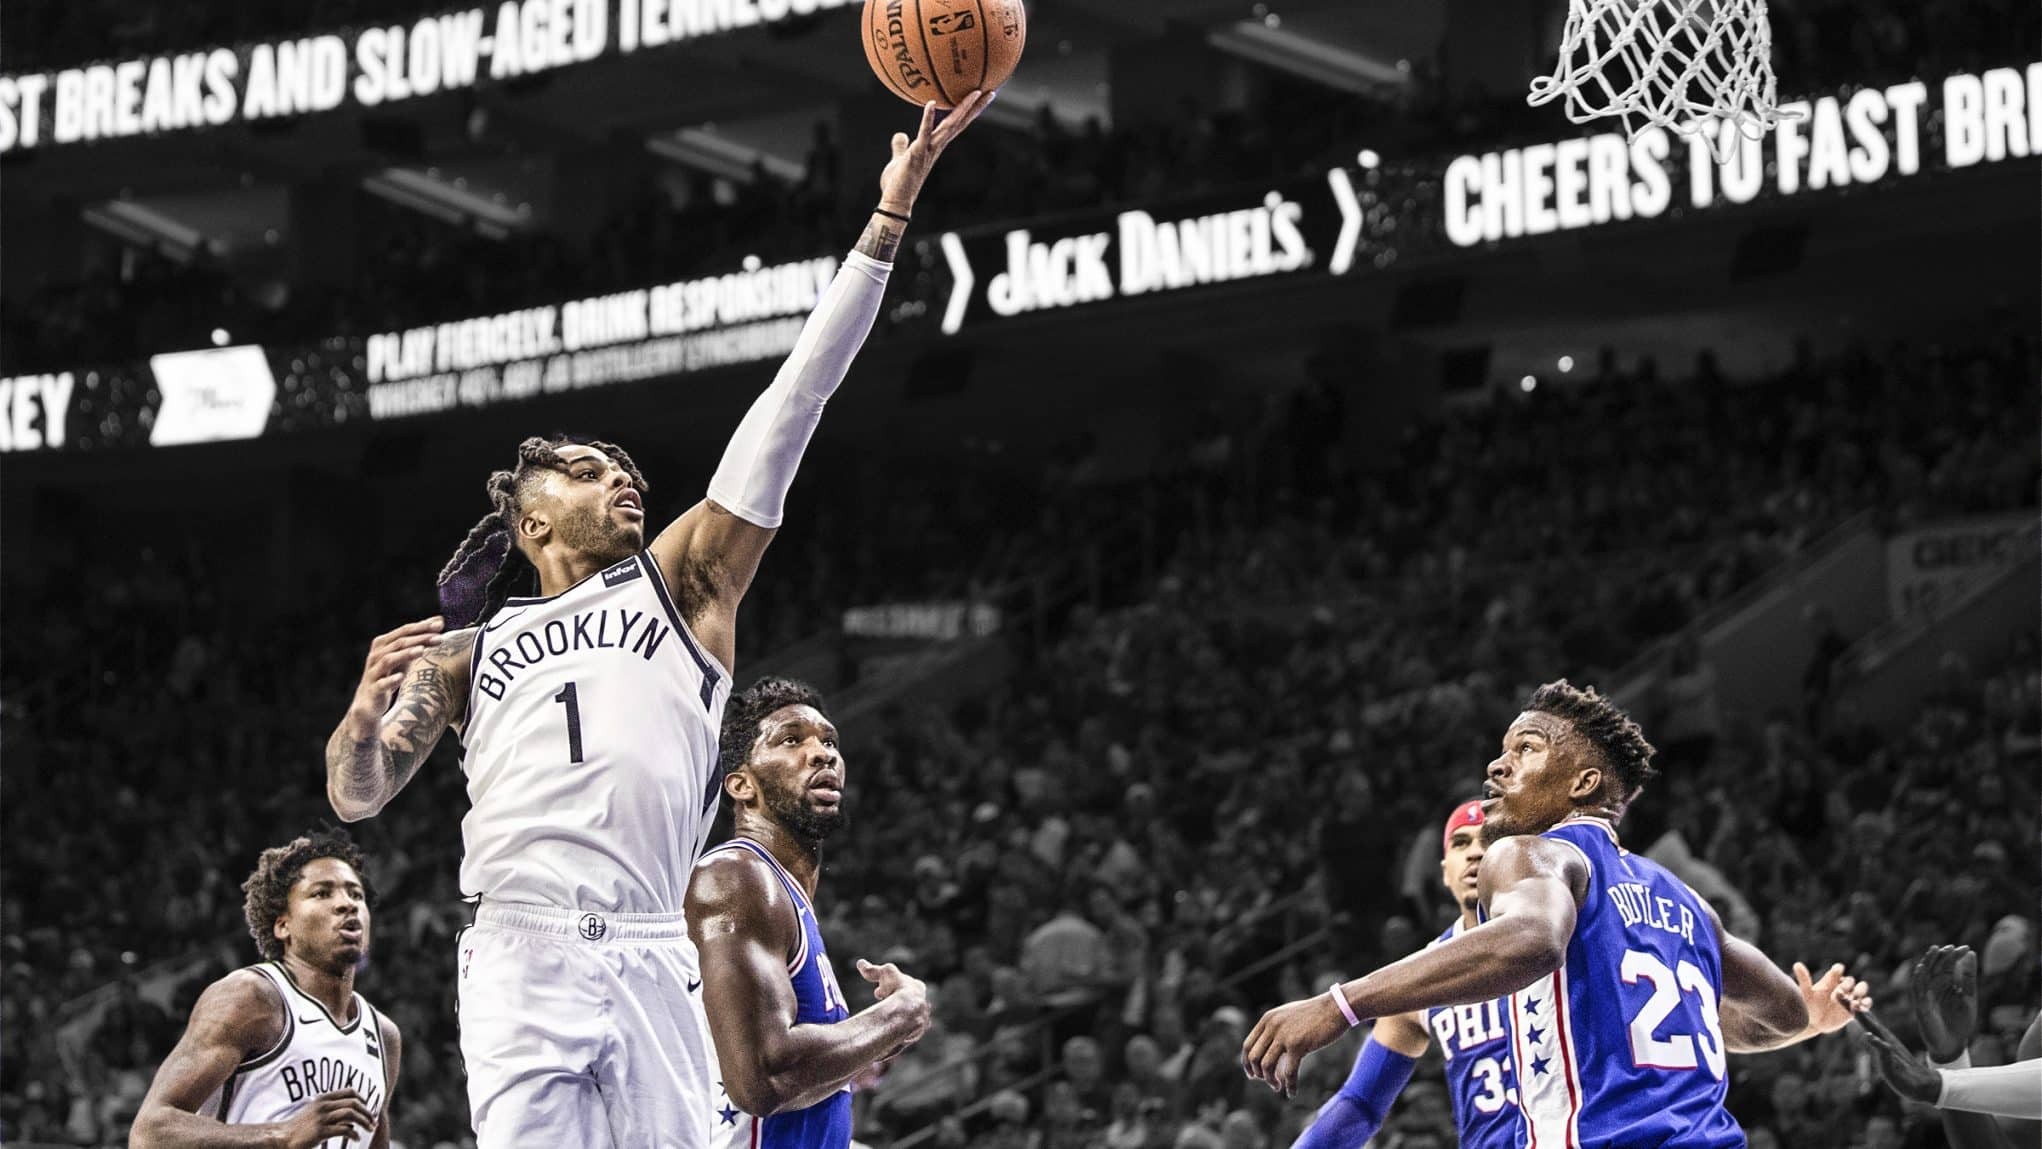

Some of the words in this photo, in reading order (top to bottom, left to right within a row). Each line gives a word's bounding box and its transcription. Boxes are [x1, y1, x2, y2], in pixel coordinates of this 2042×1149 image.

[54, 48, 239, 143] BREAKS
[243, 35, 347, 119] AND
[354, 0, 608, 105] SLOW-AGED
[1444, 127, 1671, 246] CHEERS
[1680, 110, 1763, 208] TO
[1776, 82, 1927, 194] FAST
[988, 230, 1114, 316] JACK
[367, 326, 436, 383] PLAY
[479, 608, 670, 701] BROOKLYN
[555, 681, 584, 763] 1
[1608, 882, 1695, 946] BUTLER
[1432, 998, 1505, 1061] PHI
[1620, 949, 1727, 1083] 23
